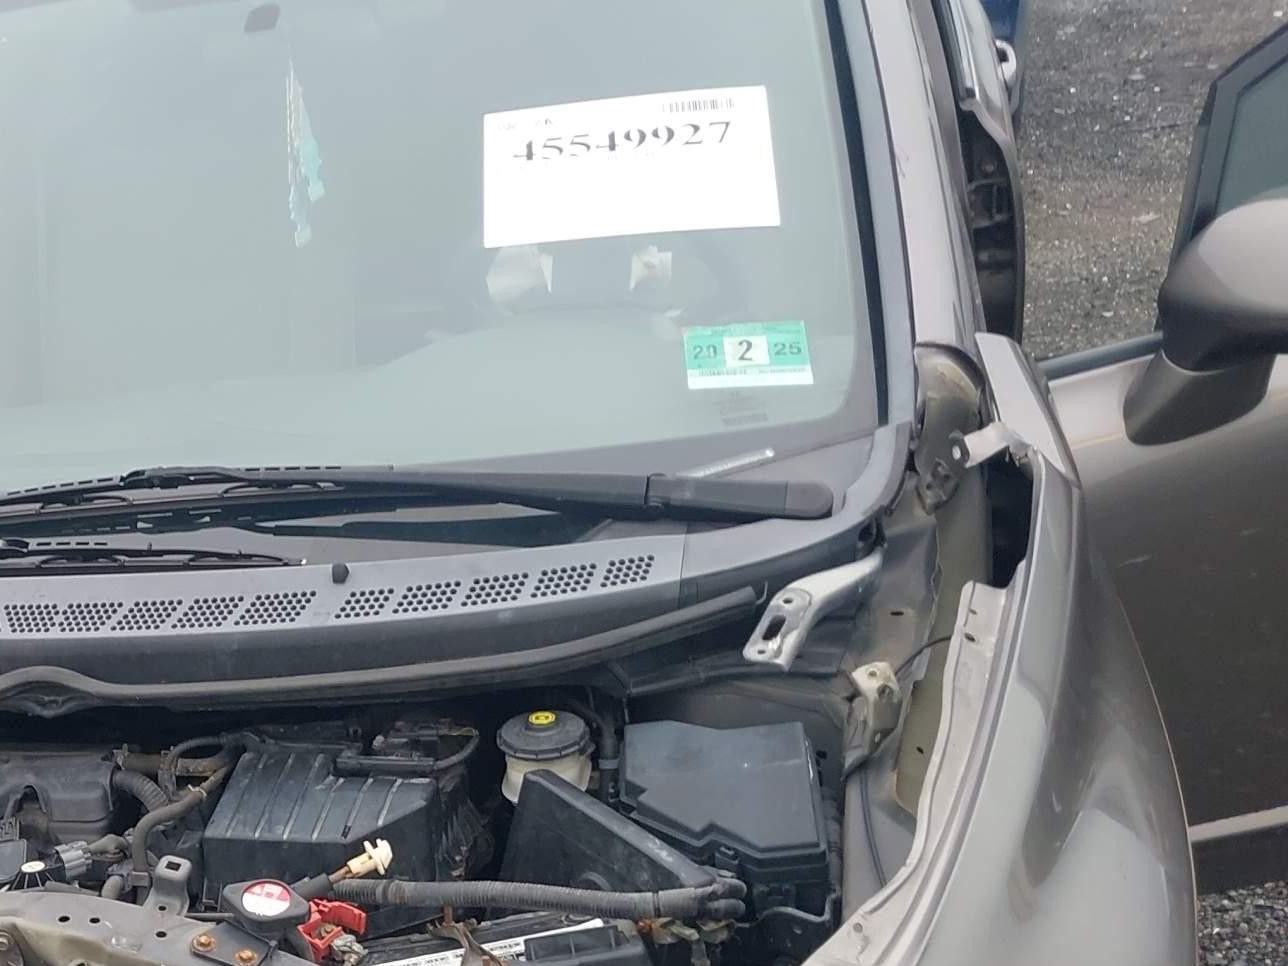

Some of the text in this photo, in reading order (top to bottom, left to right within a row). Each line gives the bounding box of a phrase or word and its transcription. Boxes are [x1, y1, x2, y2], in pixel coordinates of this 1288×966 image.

[513, 120, 731, 161] 45549927
[737, 338, 754, 362] 2
[773, 341, 803, 357] 25
